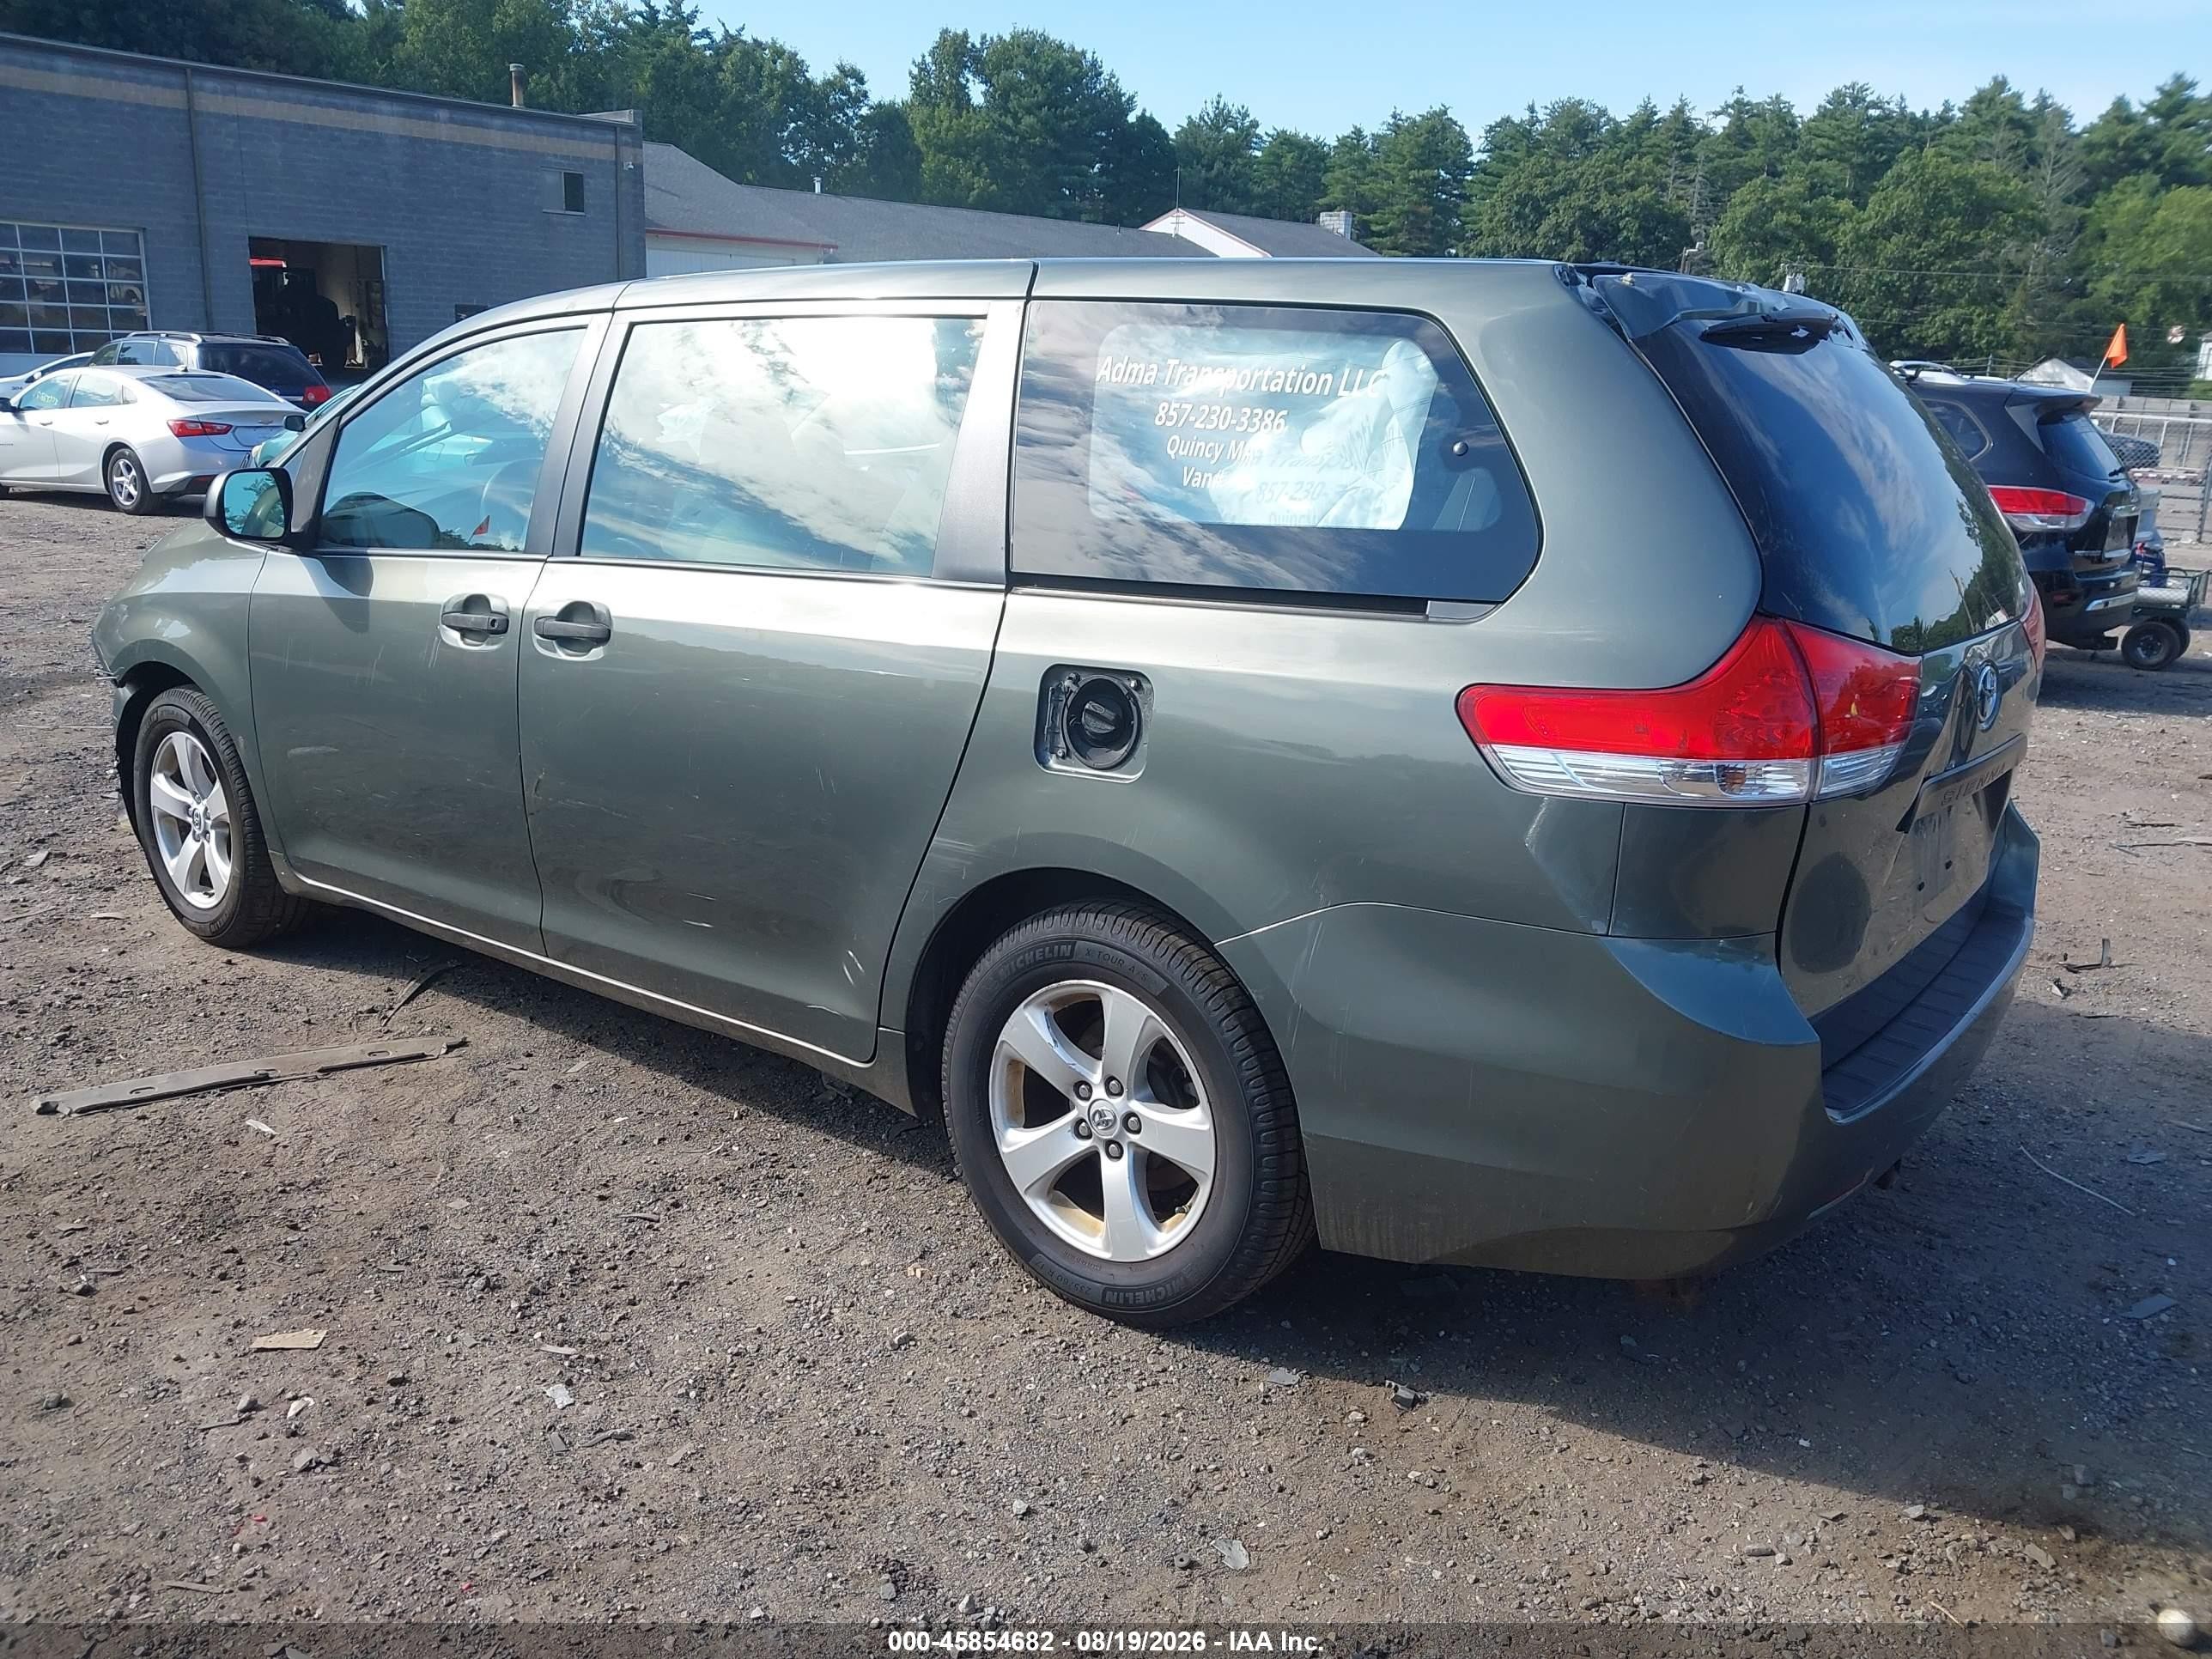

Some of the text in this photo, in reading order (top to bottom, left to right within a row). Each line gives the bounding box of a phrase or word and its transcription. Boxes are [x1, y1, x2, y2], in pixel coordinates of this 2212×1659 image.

[1096, 355, 1386, 399] Adma Transportation LLC
[1154, 400, 1288, 434] 857-230-3386
[1166, 434, 1224, 465] Quincy
